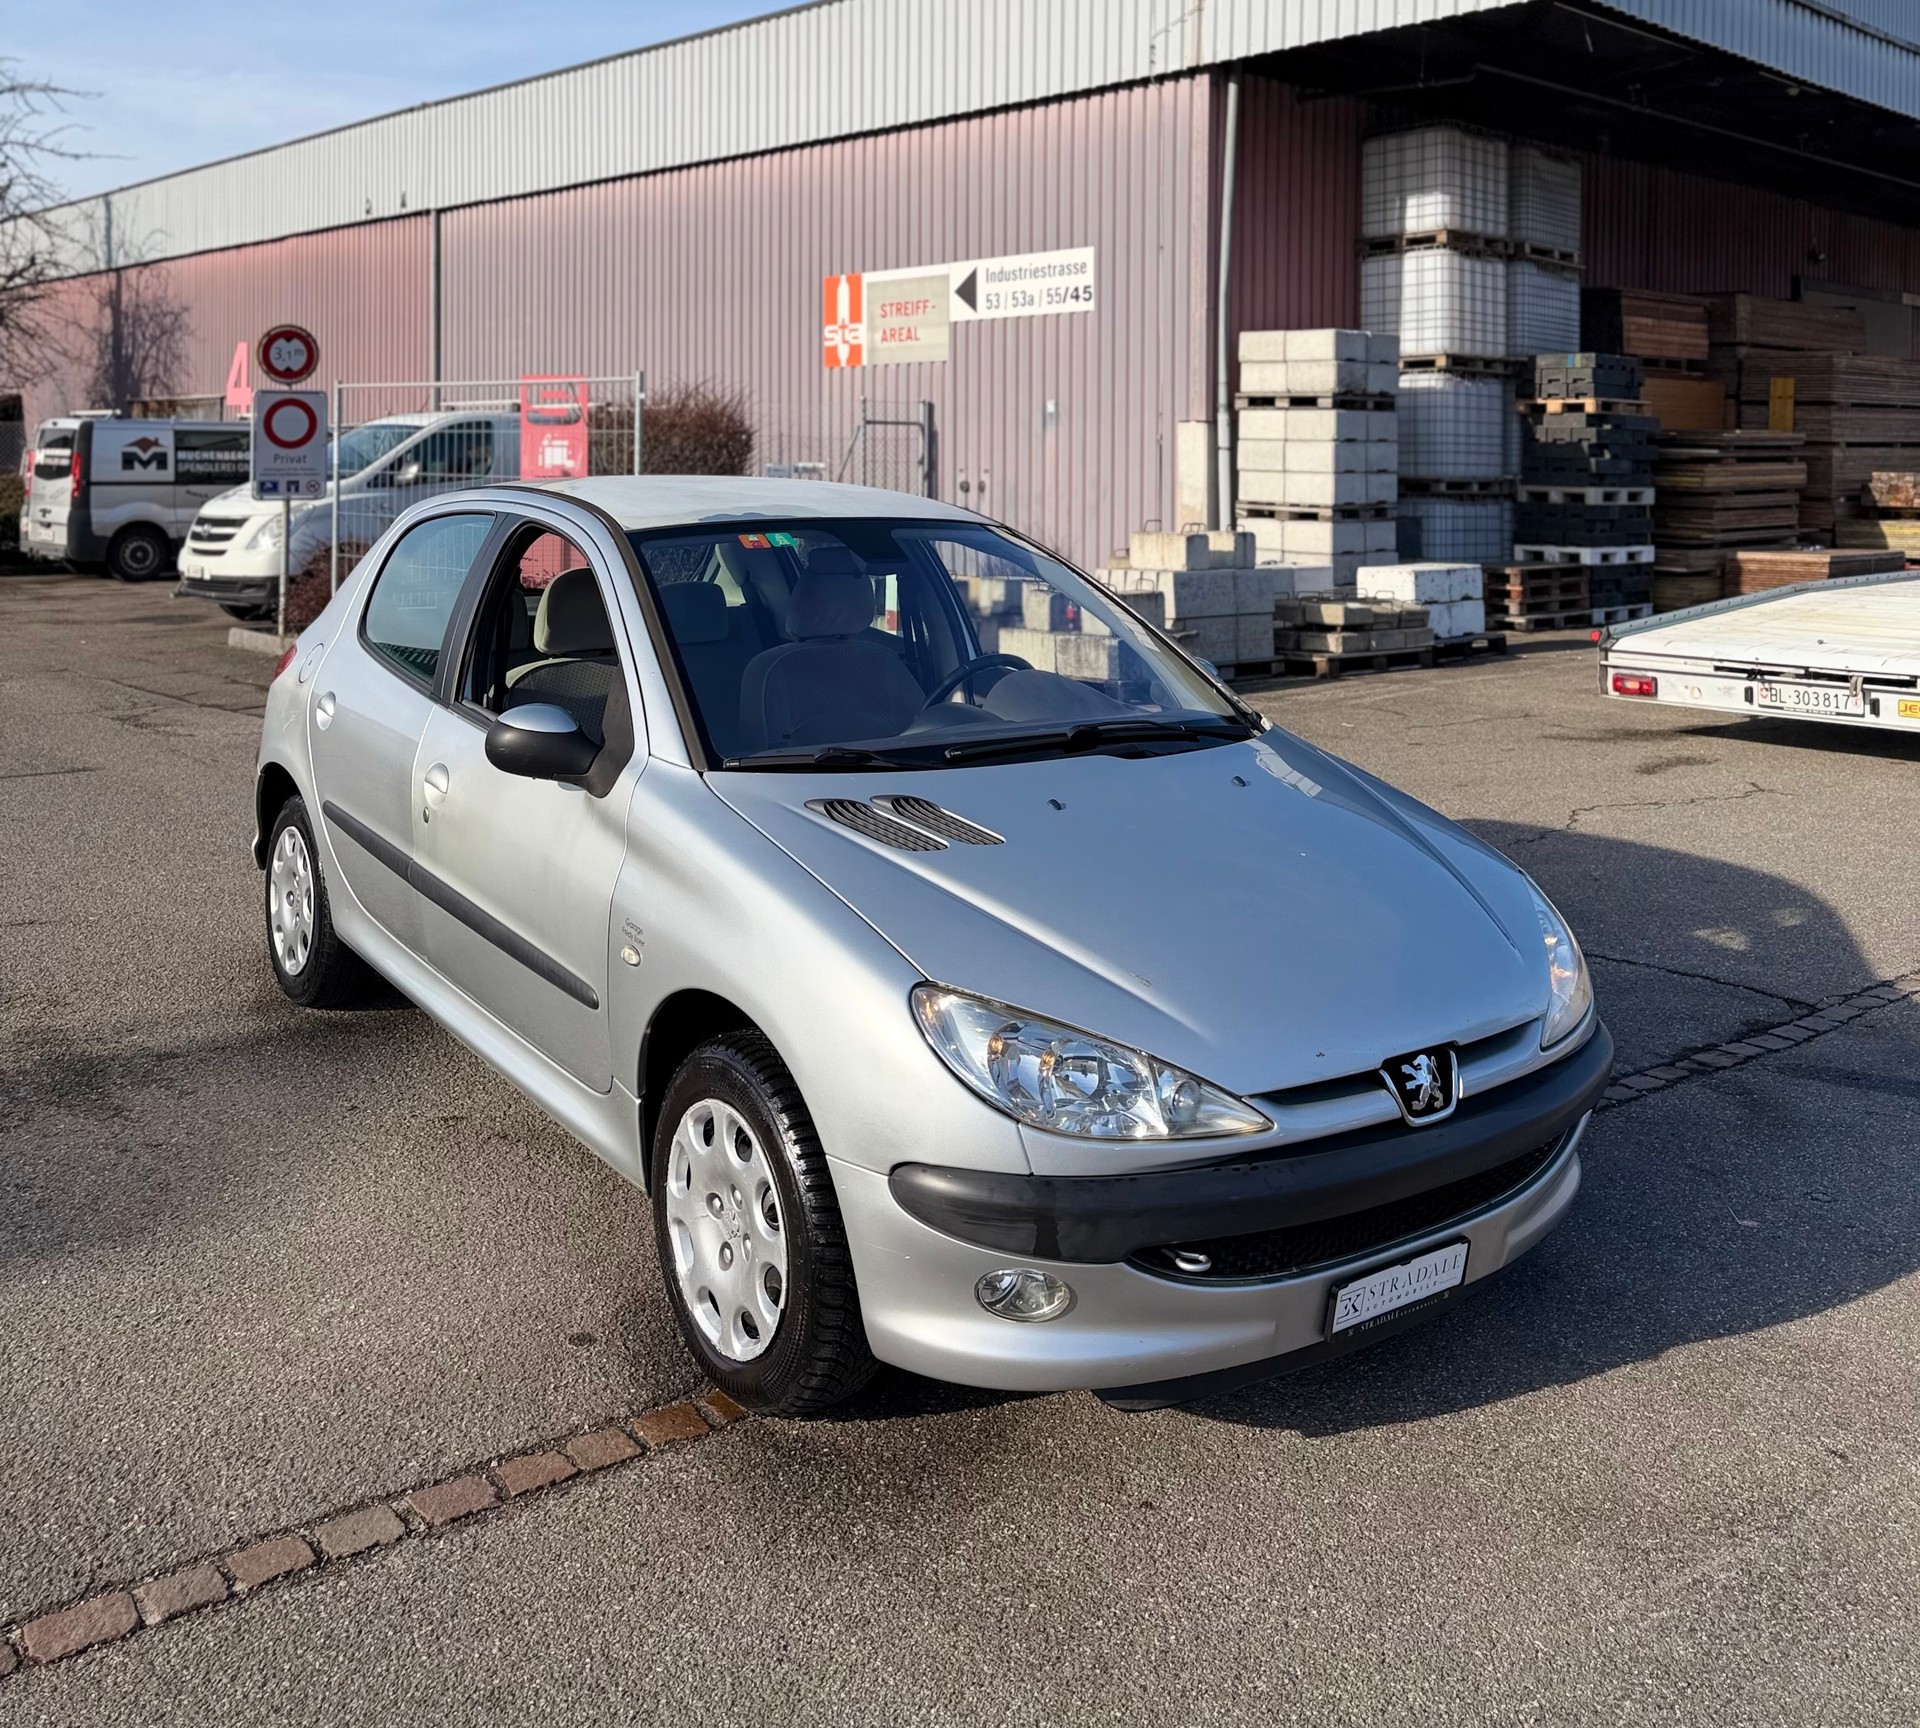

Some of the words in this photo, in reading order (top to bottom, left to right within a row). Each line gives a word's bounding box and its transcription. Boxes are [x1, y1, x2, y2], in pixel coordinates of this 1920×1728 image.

[986, 262, 1087, 283] Industriestrasse
[986, 293, 1000, 310] 53
[1011, 290, 1034, 307] 53a
[881, 326, 920, 343] AREAL
[227, 342, 252, 416] 4
[273, 453, 307, 464] Privat
[1367, 1254, 1461, 1300] STRADALE
